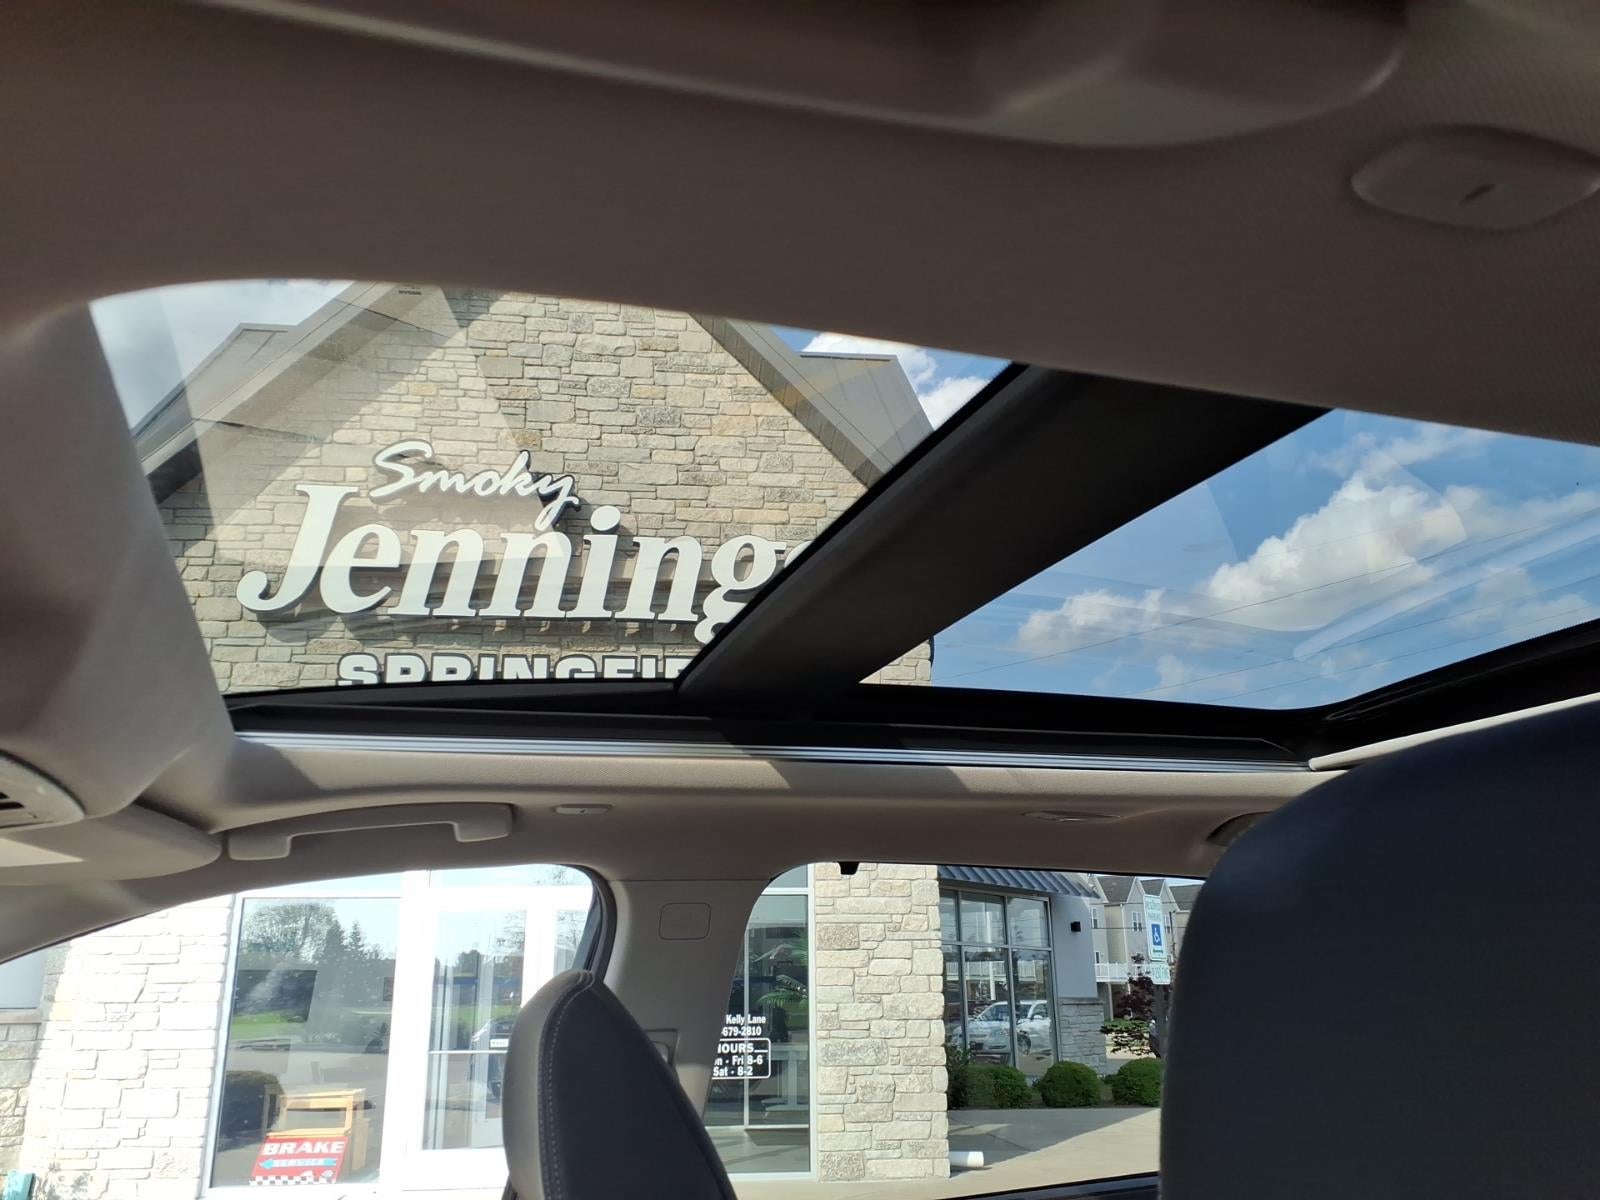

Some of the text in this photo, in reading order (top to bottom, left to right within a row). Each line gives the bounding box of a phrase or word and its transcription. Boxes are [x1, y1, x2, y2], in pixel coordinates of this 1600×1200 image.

[369, 440, 579, 531] Smoky
[236, 484, 812, 644] Jenning
[725, 1014, 766, 1025] Kelly Lane
[731, 1055, 744, 1066] Fri
[746, 1055, 763, 1065] 8-6
[713, 1066, 753, 1077] Sat 8-2
[262, 1141, 345, 1156] BRAKE
